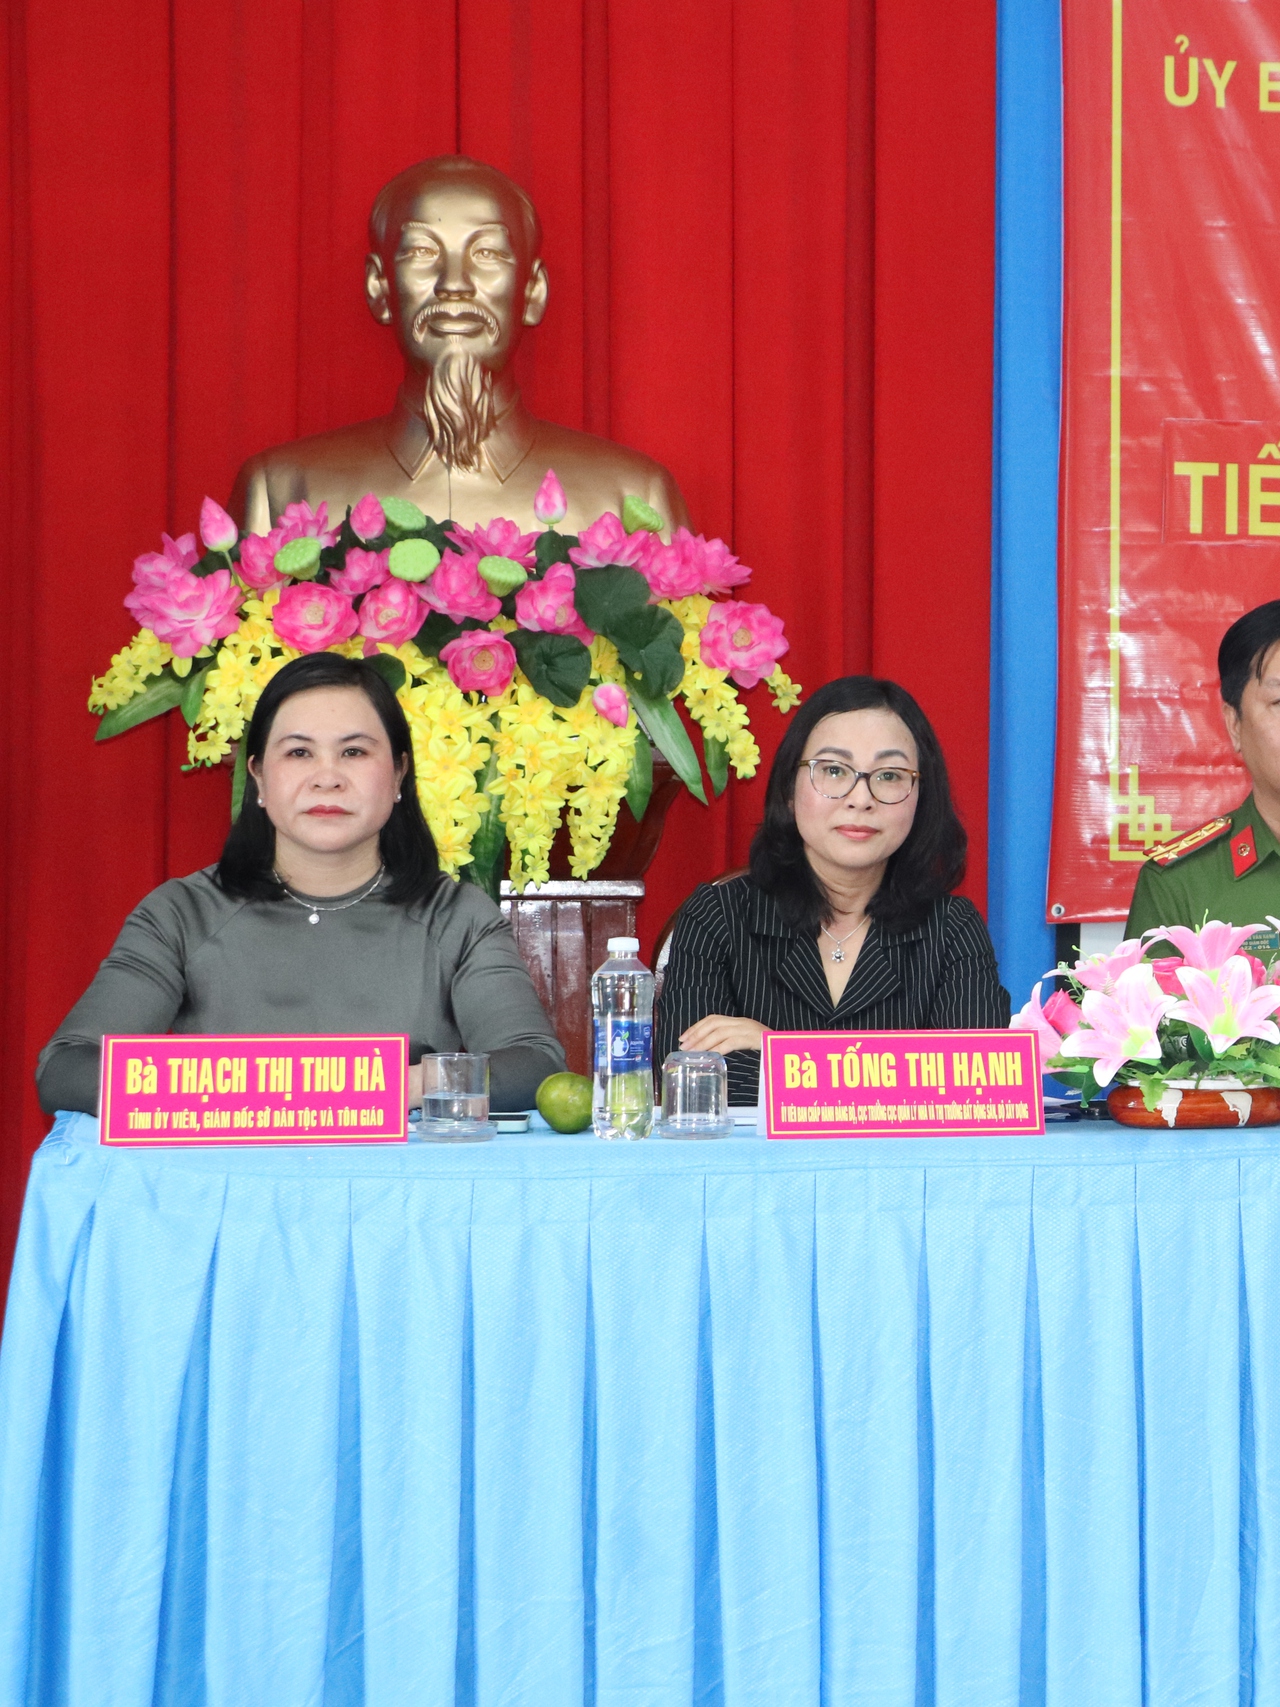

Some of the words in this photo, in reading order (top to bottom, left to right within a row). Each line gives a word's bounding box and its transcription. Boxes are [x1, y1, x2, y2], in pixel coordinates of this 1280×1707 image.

[1164, 34, 1237, 108] ỦY
[126, 1057, 157, 1094] Bà
[167, 1057, 247, 1102] THẠCH
[255, 1057, 292, 1101] THỊ
[300, 1057, 346, 1092] THU
[354, 1048, 385, 1091] HÀ
[784, 1052, 817, 1088] Bà
[827, 1042, 897, 1088] TỐNG
[905, 1053, 945, 1095] THỊ
[953, 1052, 1022, 1095] HẠNH
[128, 1108, 152, 1129] TỈNH
[154, 1107, 169, 1129] ỦY
[172, 1108, 200, 1131] VIÊN,
[203, 1108, 230, 1128] GIÁM
[233, 1106, 254, 1128] ĐỐC
[256, 1106, 271, 1128] SỞ
[273, 1107, 295, 1127] DÂN
[297, 1107, 317, 1130] TỘC
[320, 1107, 334, 1126] VÀ
[337, 1106, 357, 1126] TÔN
[360, 1106, 384, 1126] GIÁO
